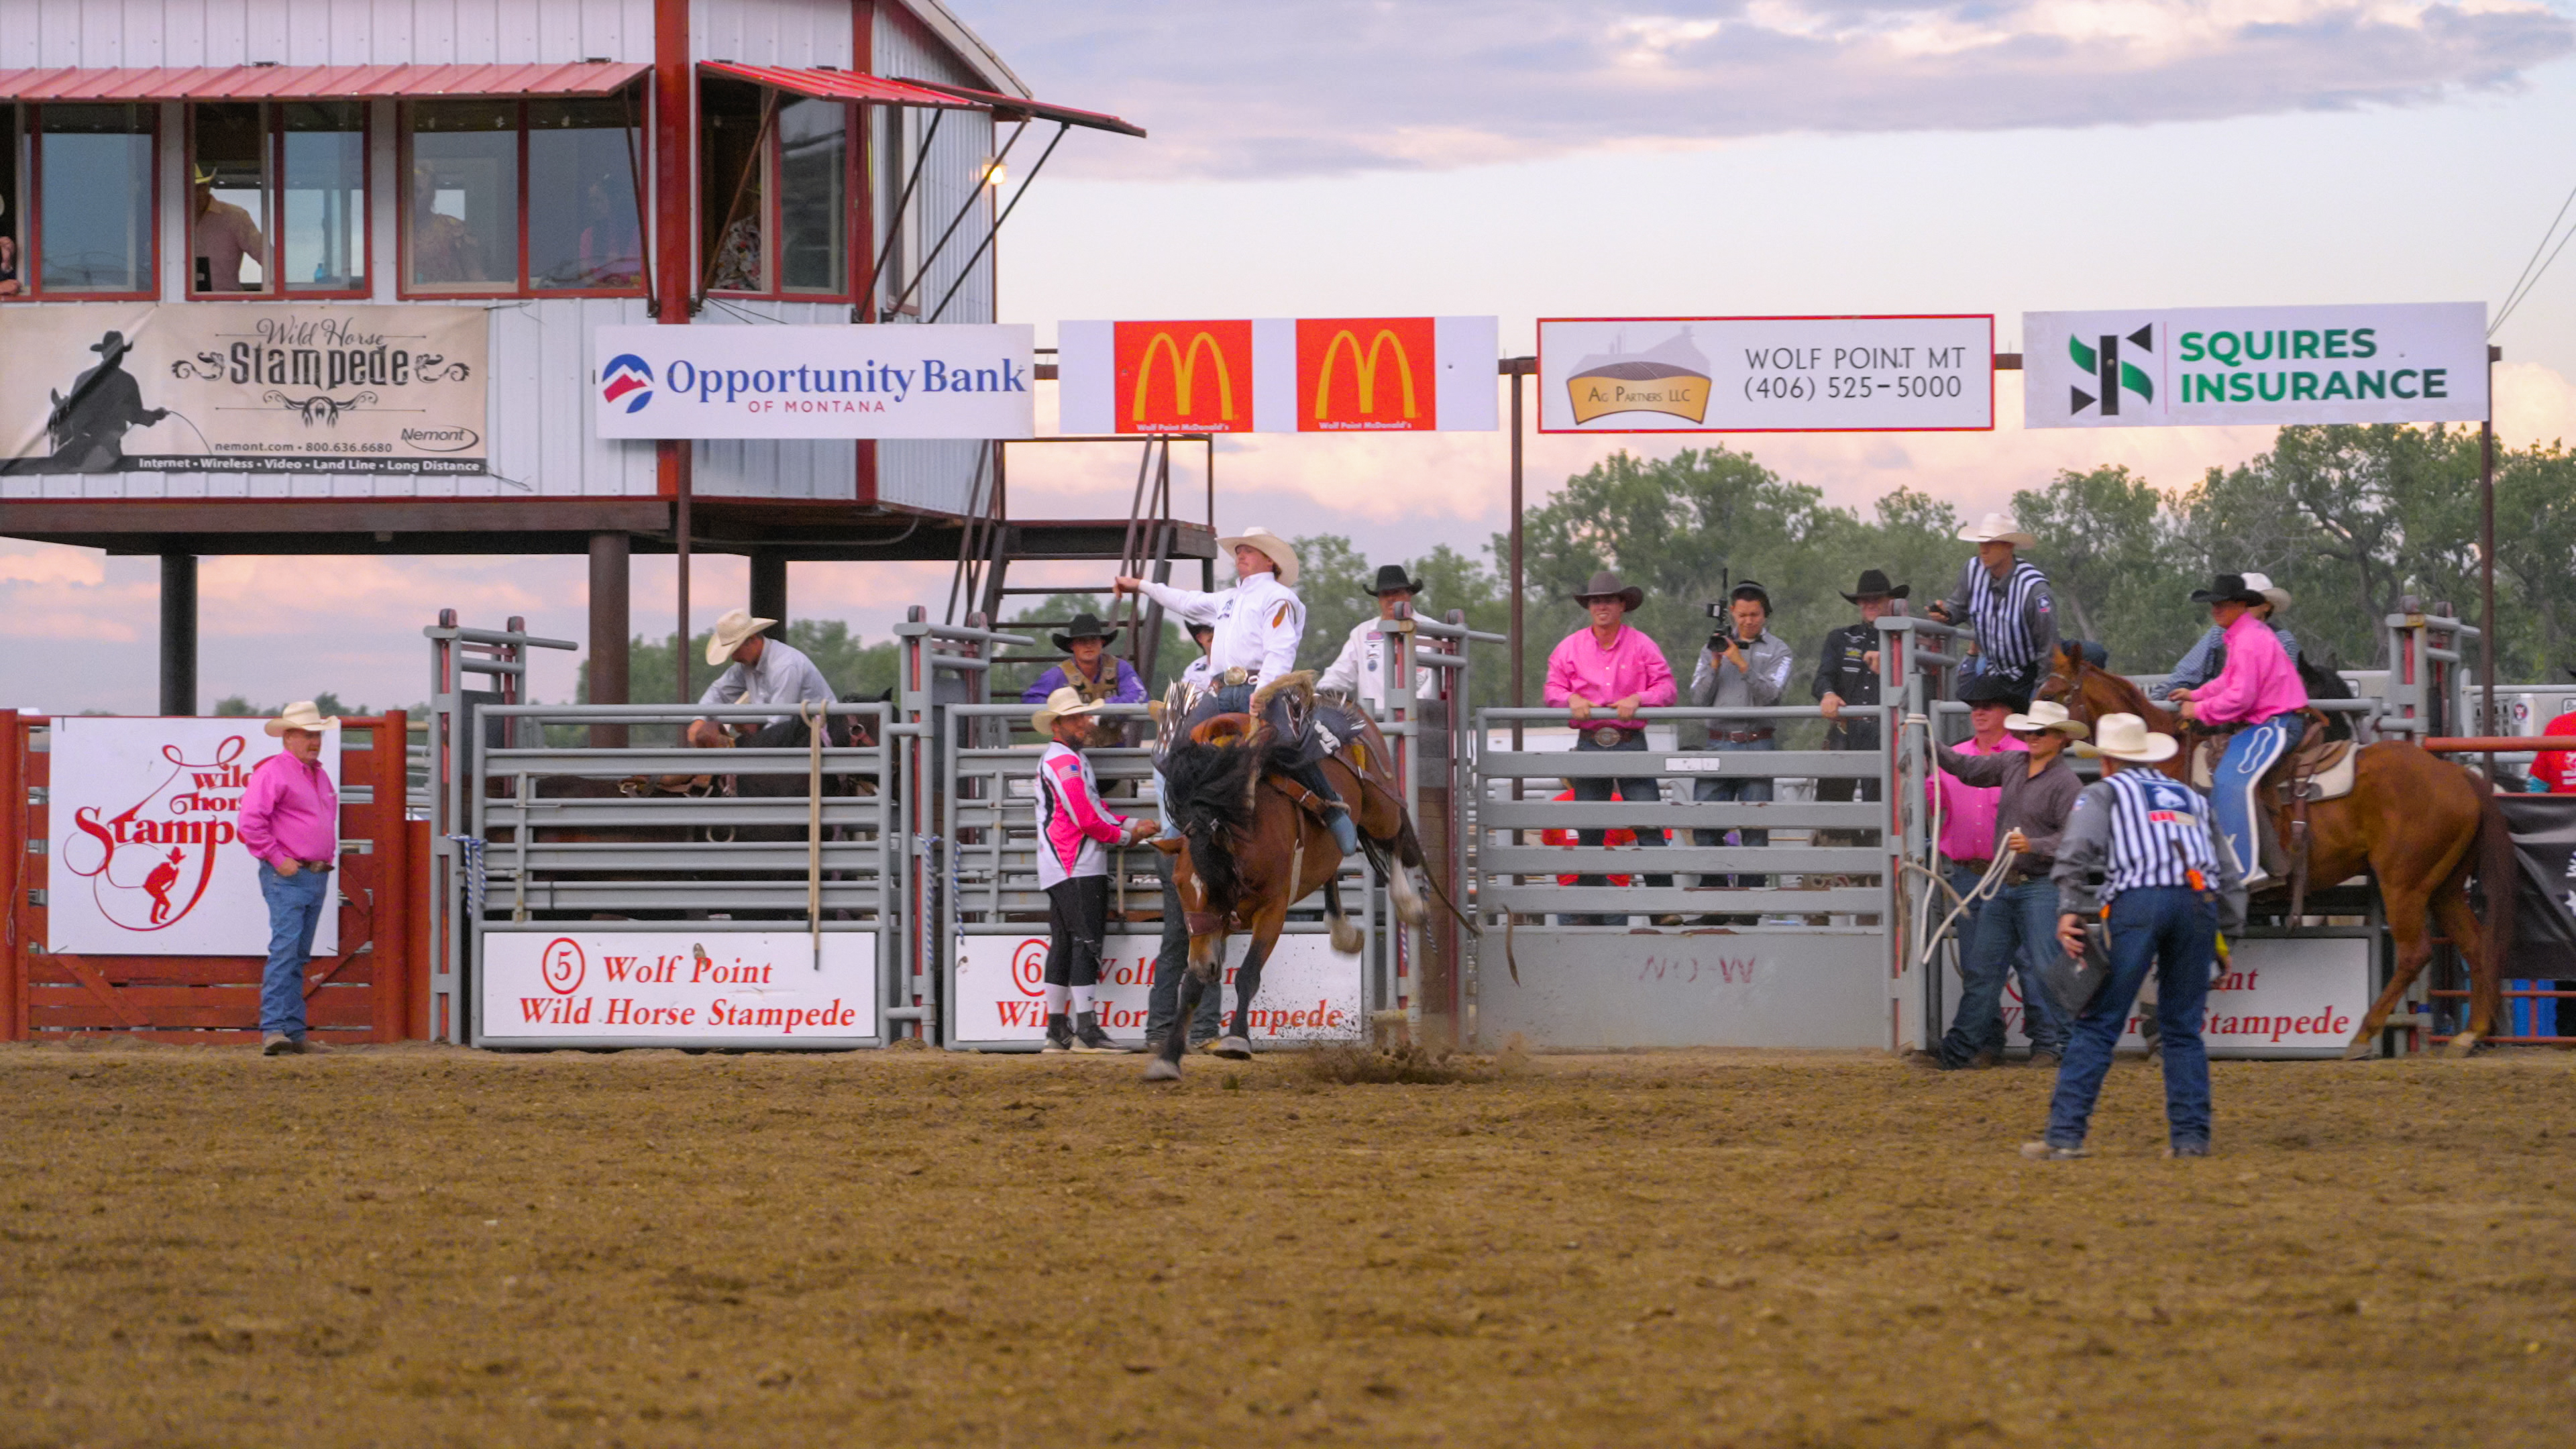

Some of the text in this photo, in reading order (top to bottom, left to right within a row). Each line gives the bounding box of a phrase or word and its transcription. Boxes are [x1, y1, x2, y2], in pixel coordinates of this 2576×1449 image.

[257, 315, 384, 347] Wild Horse
[1744, 347, 1966, 370] WOLF POINT MT
[2180, 327, 2377, 367] SQUIRES
[230, 341, 409, 390] Stampede
[667, 358, 1026, 402] Opportunity Bank
[1743, 375, 1962, 402] (406) 525-5000
[2181, 368, 2448, 403] INSURANCE
[749, 400, 885, 413] OF MONTANA
[1669, 389, 1690, 402] LLC
[400, 428, 465, 441] Nemont
[1318, 421, 1340, 429] Wolf
[215, 442, 392, 452] nemont.com 800.636.6680
[139, 458, 480, 472] Internet Wireless Video Land Line Long Distance
[170, 792, 244, 815] hor
[553, 950, 773, 984] 5 Wolf Point
[1024, 953, 1042, 983] 6
[520, 996, 855, 1034] Wild Horse Stampede
[996, 998, 1344, 1036] Wil Hor ampede
